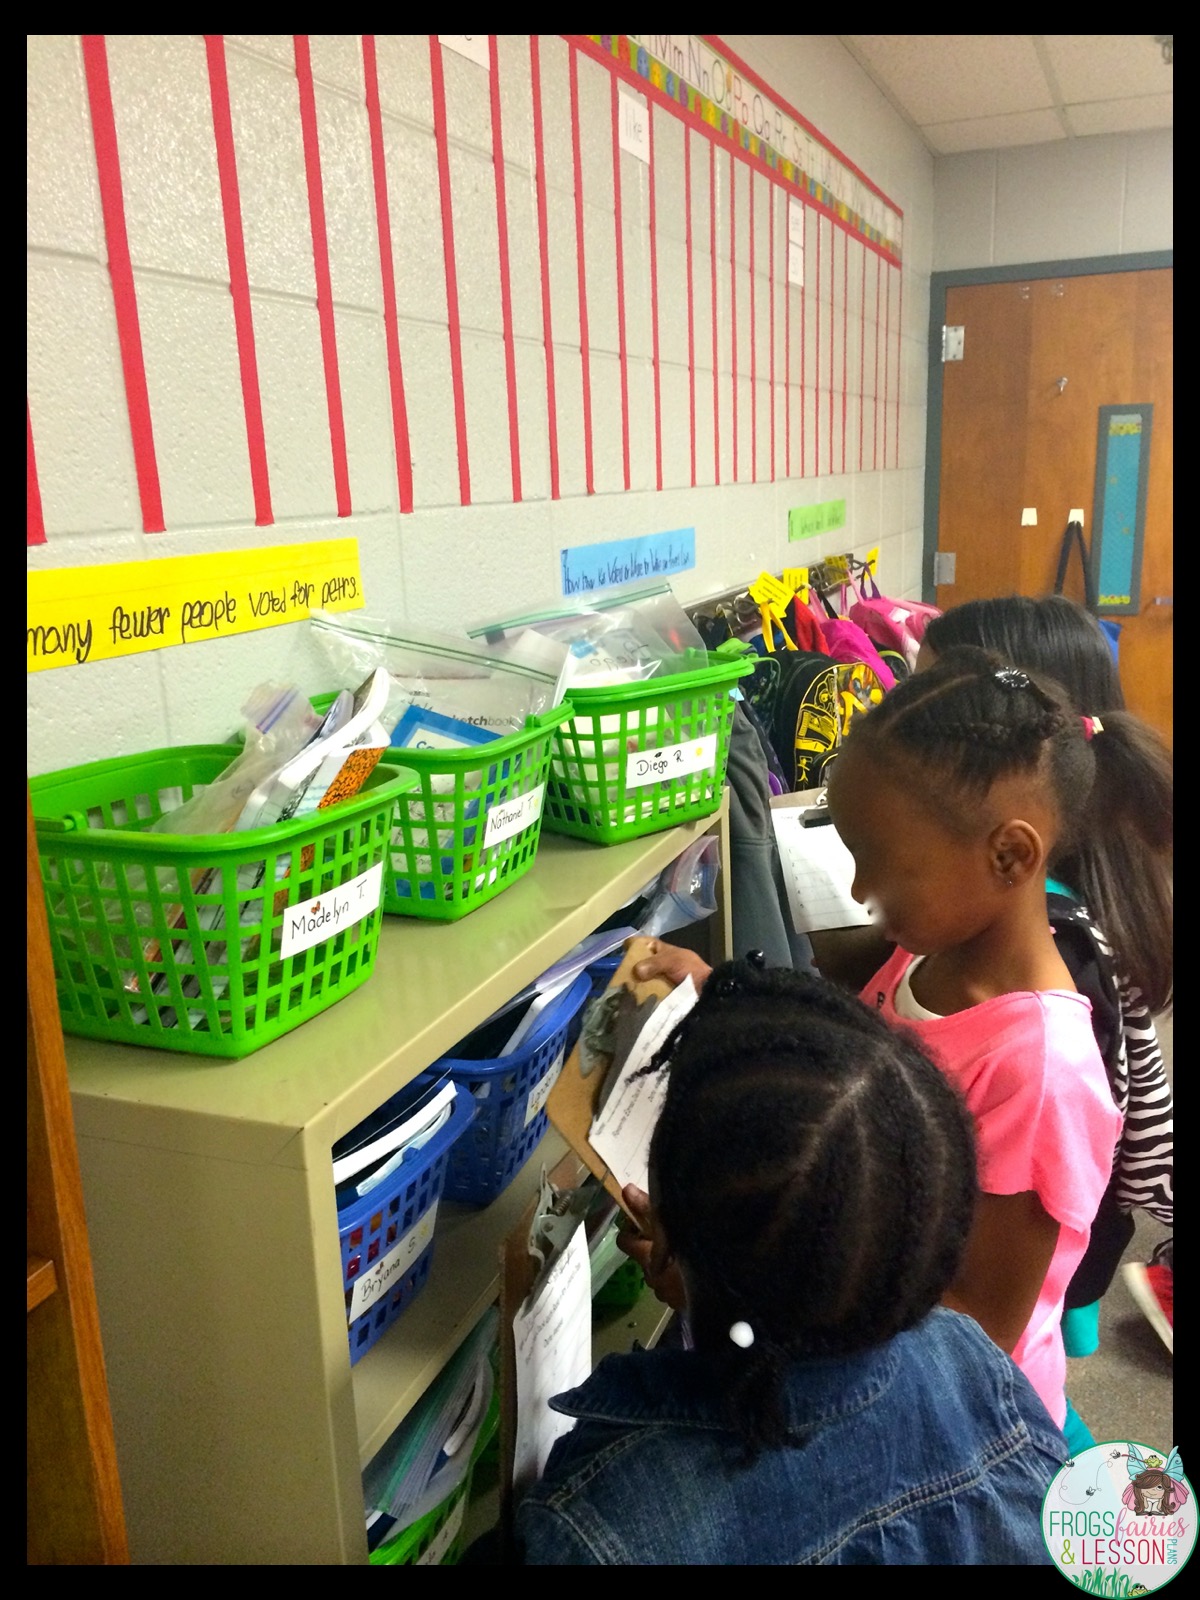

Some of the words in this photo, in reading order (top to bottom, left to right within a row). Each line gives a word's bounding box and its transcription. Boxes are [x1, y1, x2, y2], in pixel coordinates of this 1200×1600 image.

[27, 620, 93, 664] many
[109, 606, 171, 645] fewer
[181, 591, 237, 644] people
[290, 580, 315, 608] for
[636, 759, 668, 775] Diego
[490, 801, 524, 833] Nathaniel
[291, 896, 350, 940] Madelyn
[356, 878, 368, 900] T.
[361, 1258, 401, 1303] Bryana
